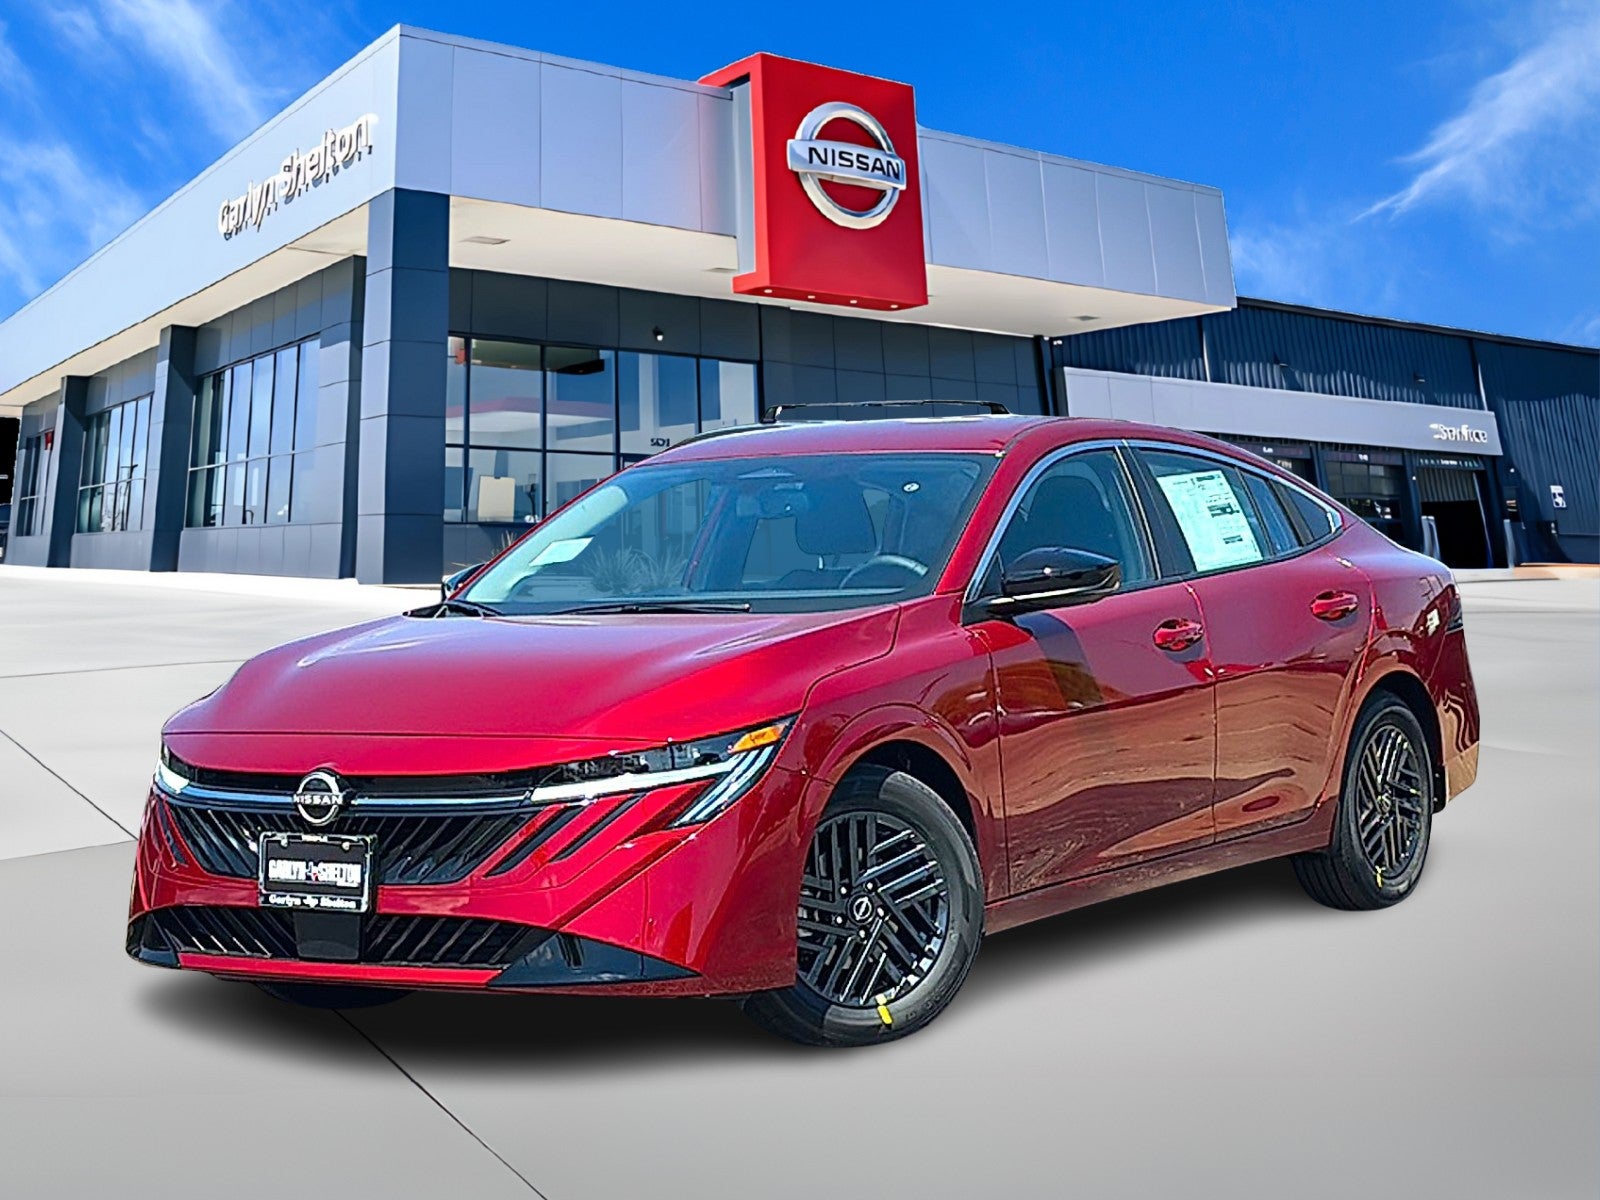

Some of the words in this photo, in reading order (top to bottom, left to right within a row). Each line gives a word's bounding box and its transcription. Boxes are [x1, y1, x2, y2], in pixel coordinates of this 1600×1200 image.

[279, 116, 373, 200] Shelton
[808, 146, 900, 181] NISSAN
[1429, 423, 1488, 443] Service
[293, 793, 343, 805] NISSAN
